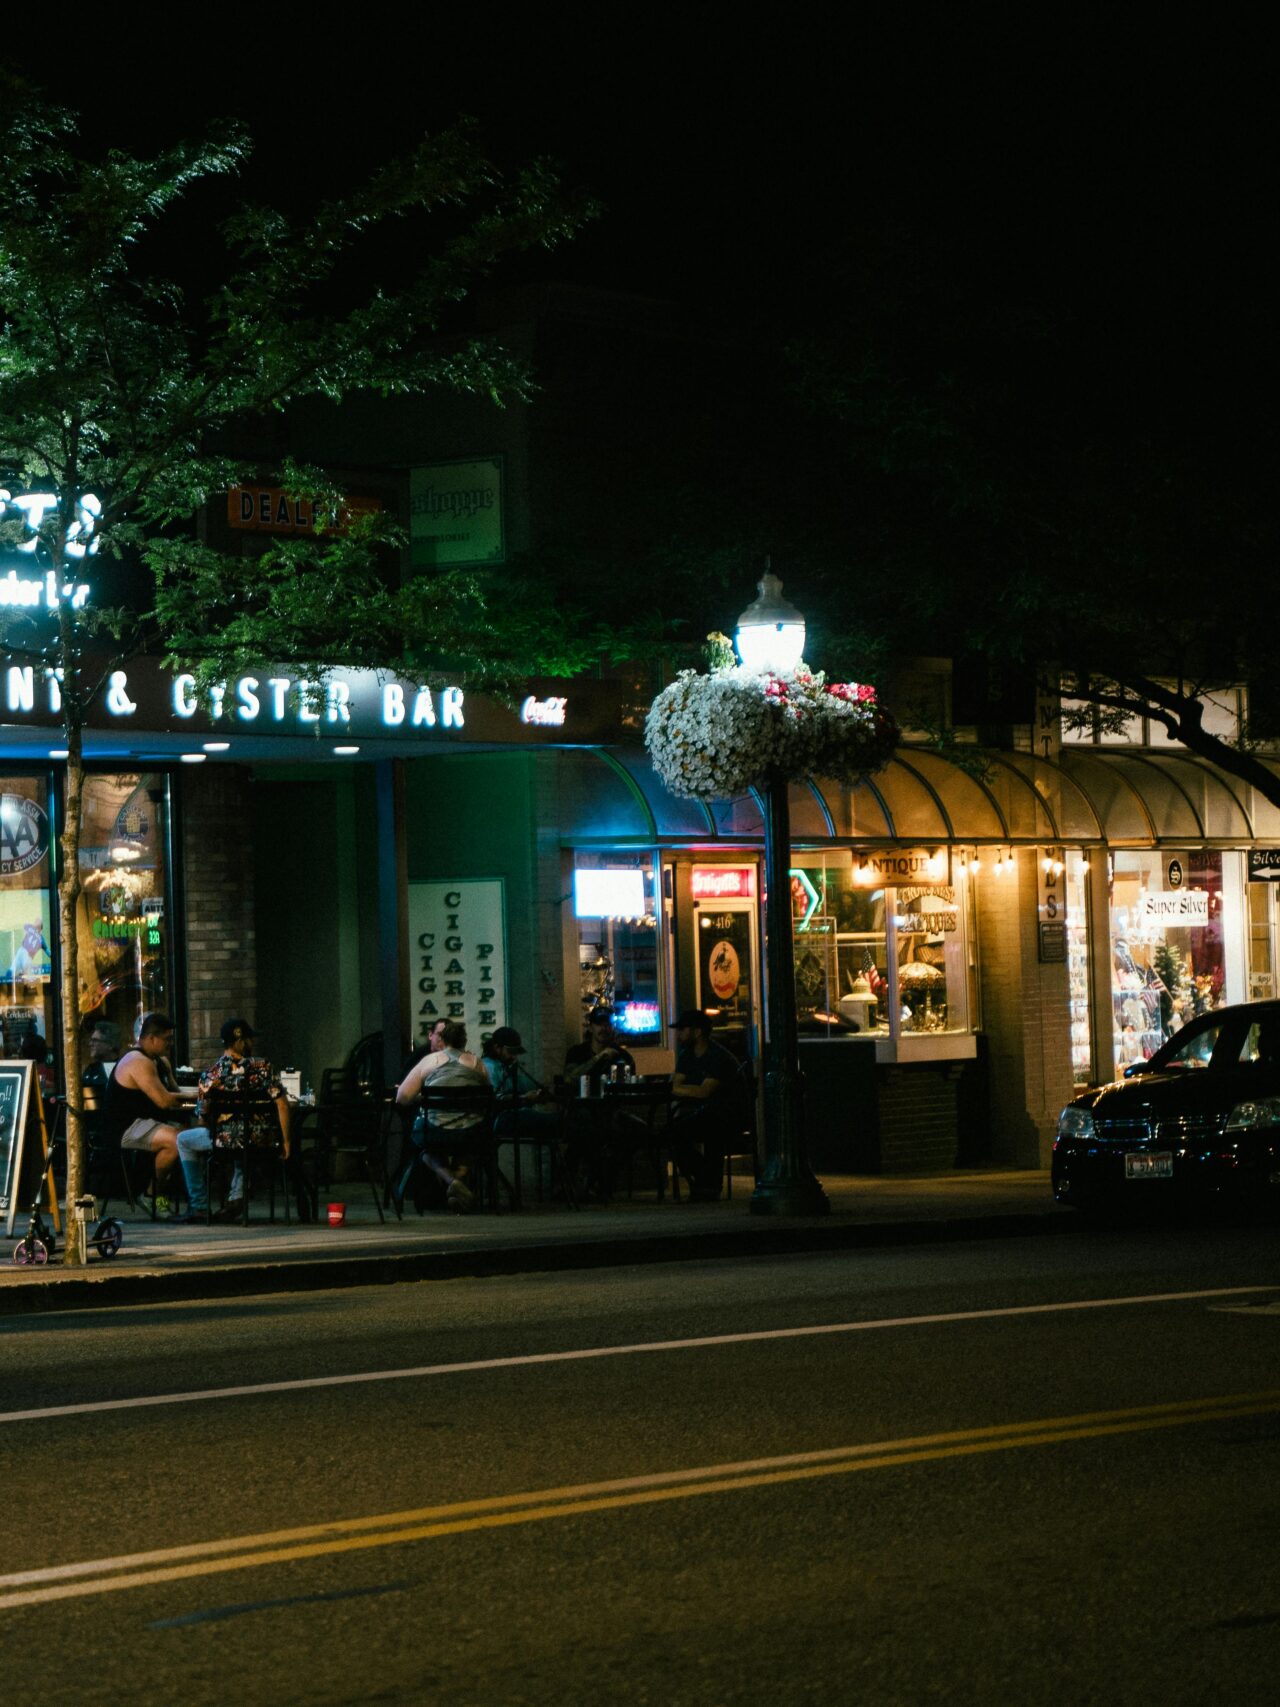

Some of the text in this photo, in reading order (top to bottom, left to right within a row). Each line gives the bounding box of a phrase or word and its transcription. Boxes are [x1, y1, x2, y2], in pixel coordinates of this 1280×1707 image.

[106, 669, 137, 716] &
[382, 683, 465, 728] BAR
[13, 846, 42, 871] SERVICE
[1146, 895, 1207, 915] Super Silver
